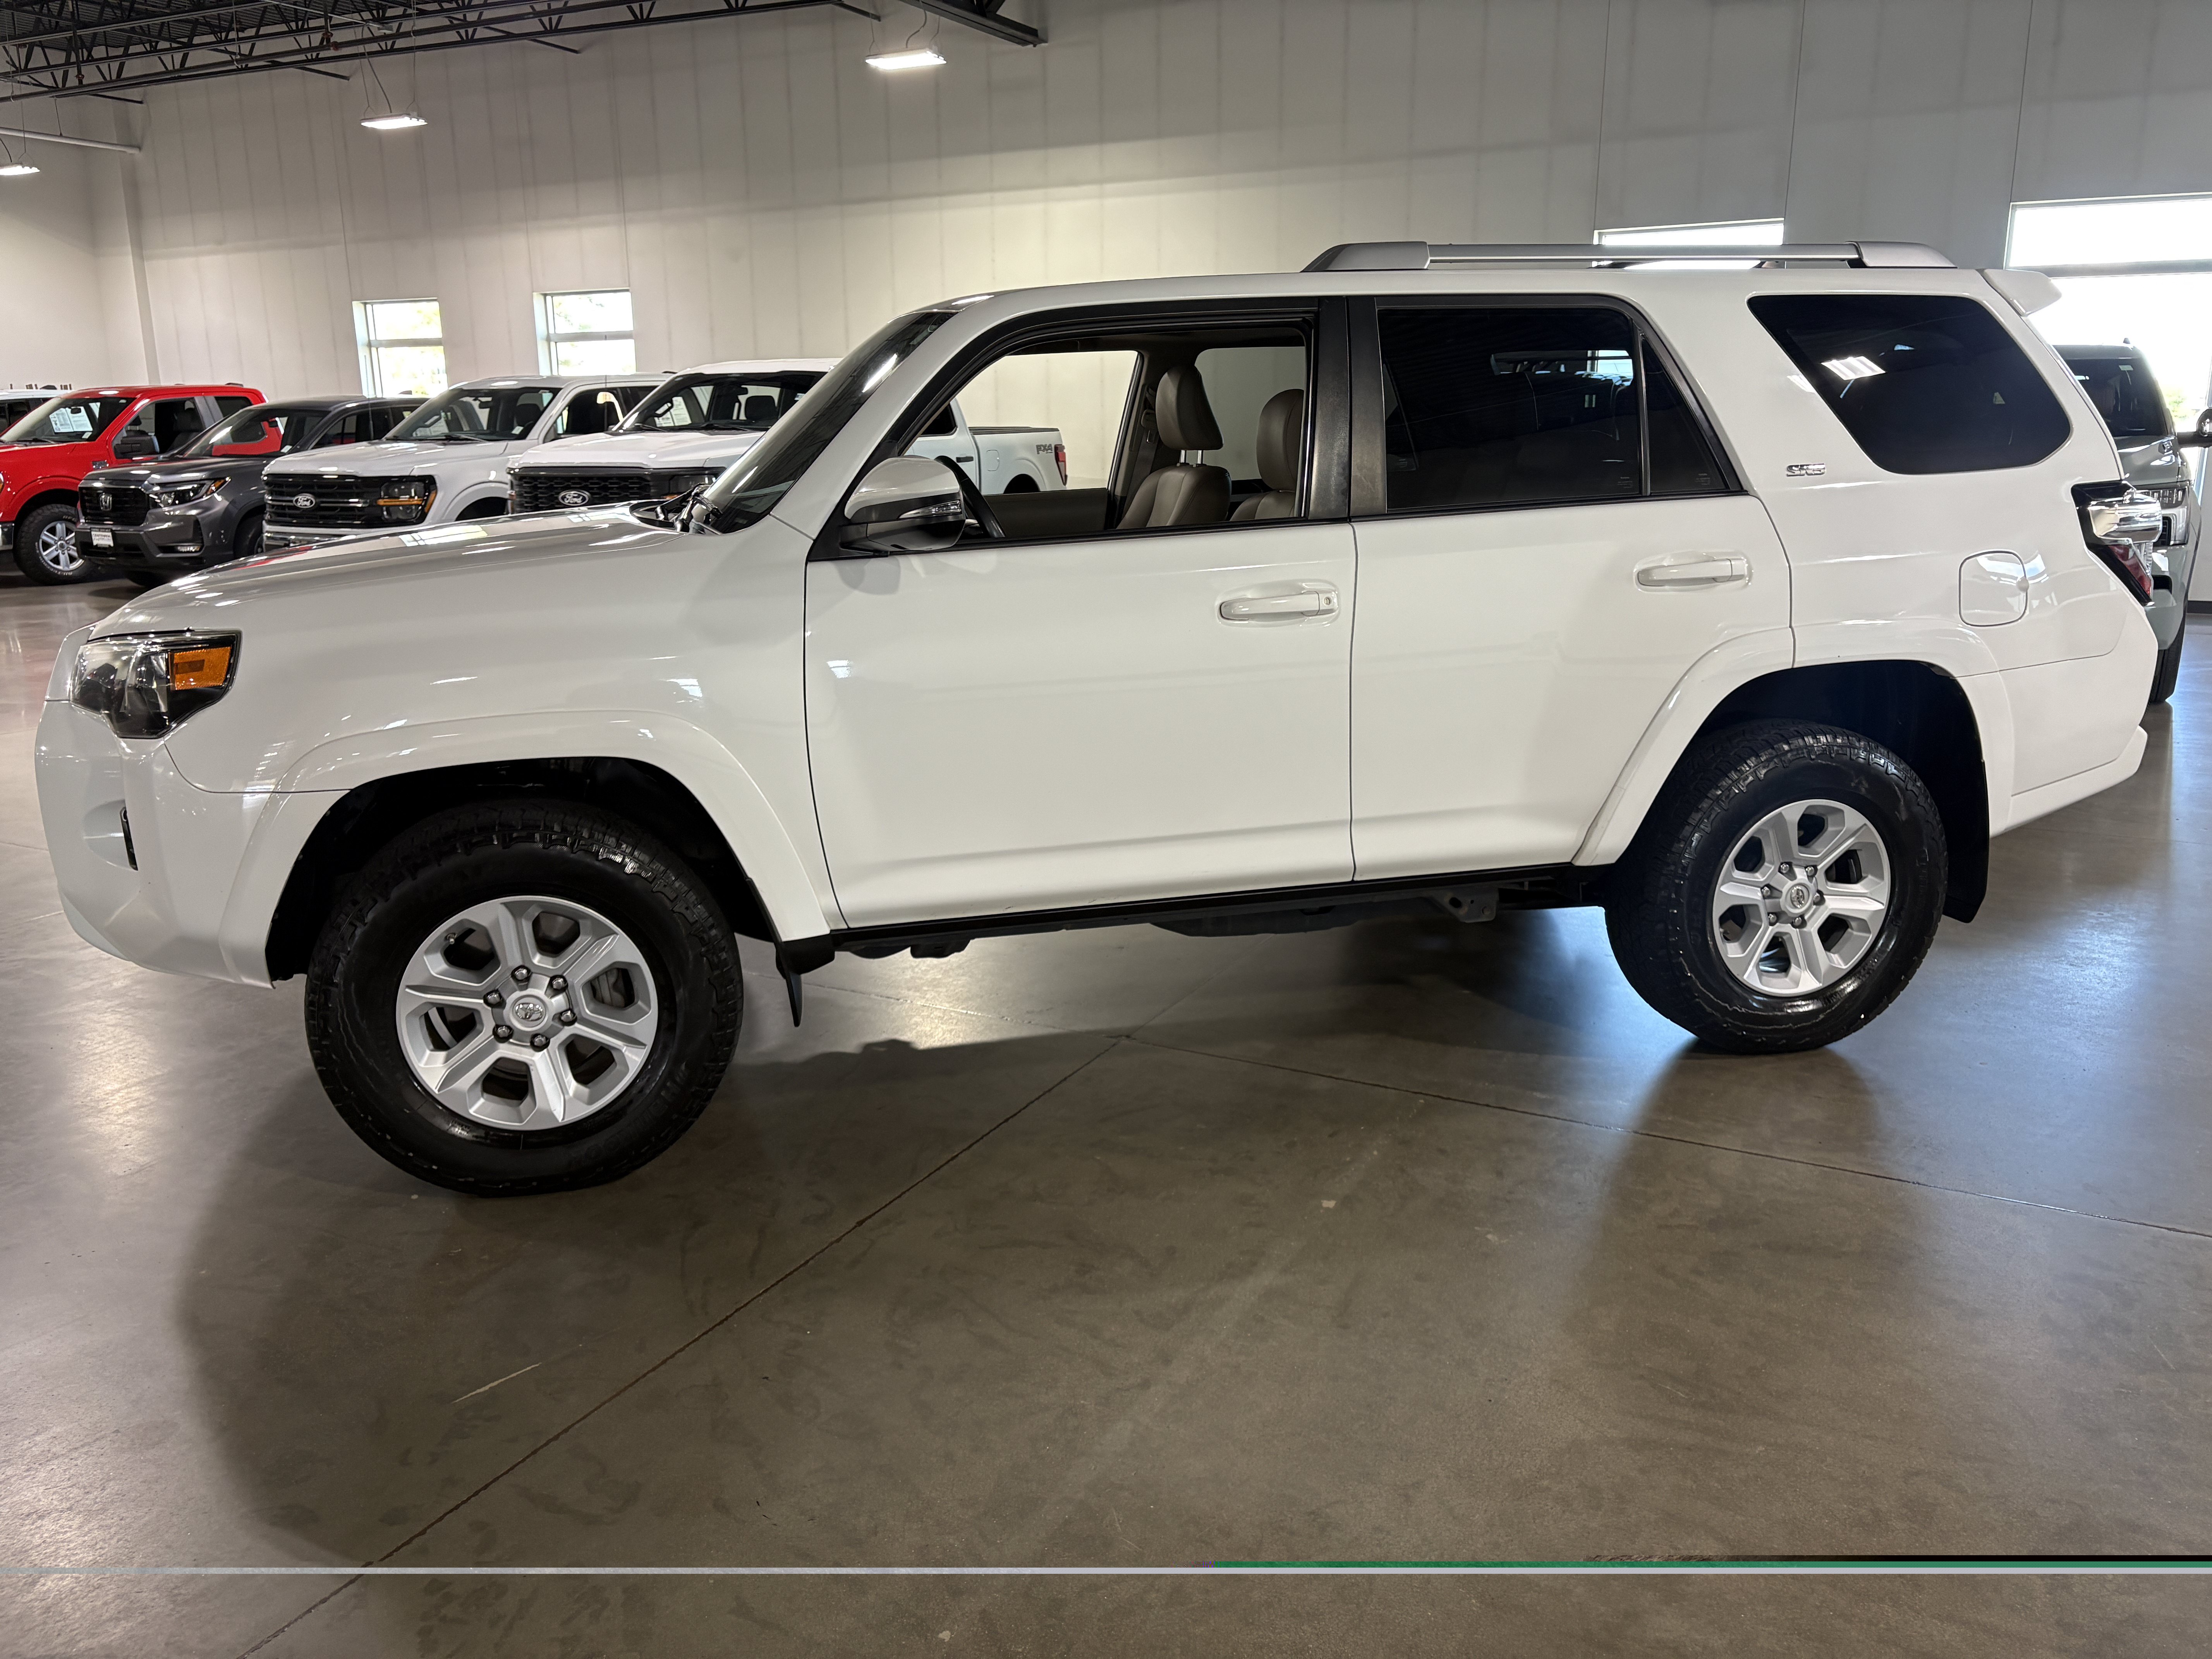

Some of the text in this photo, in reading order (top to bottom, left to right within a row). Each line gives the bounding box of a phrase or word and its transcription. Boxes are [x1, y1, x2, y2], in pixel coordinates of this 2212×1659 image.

[1786, 464, 1825, 477] SR5
[295, 496, 312, 507] Ford
[563, 493, 584, 504] Ford
